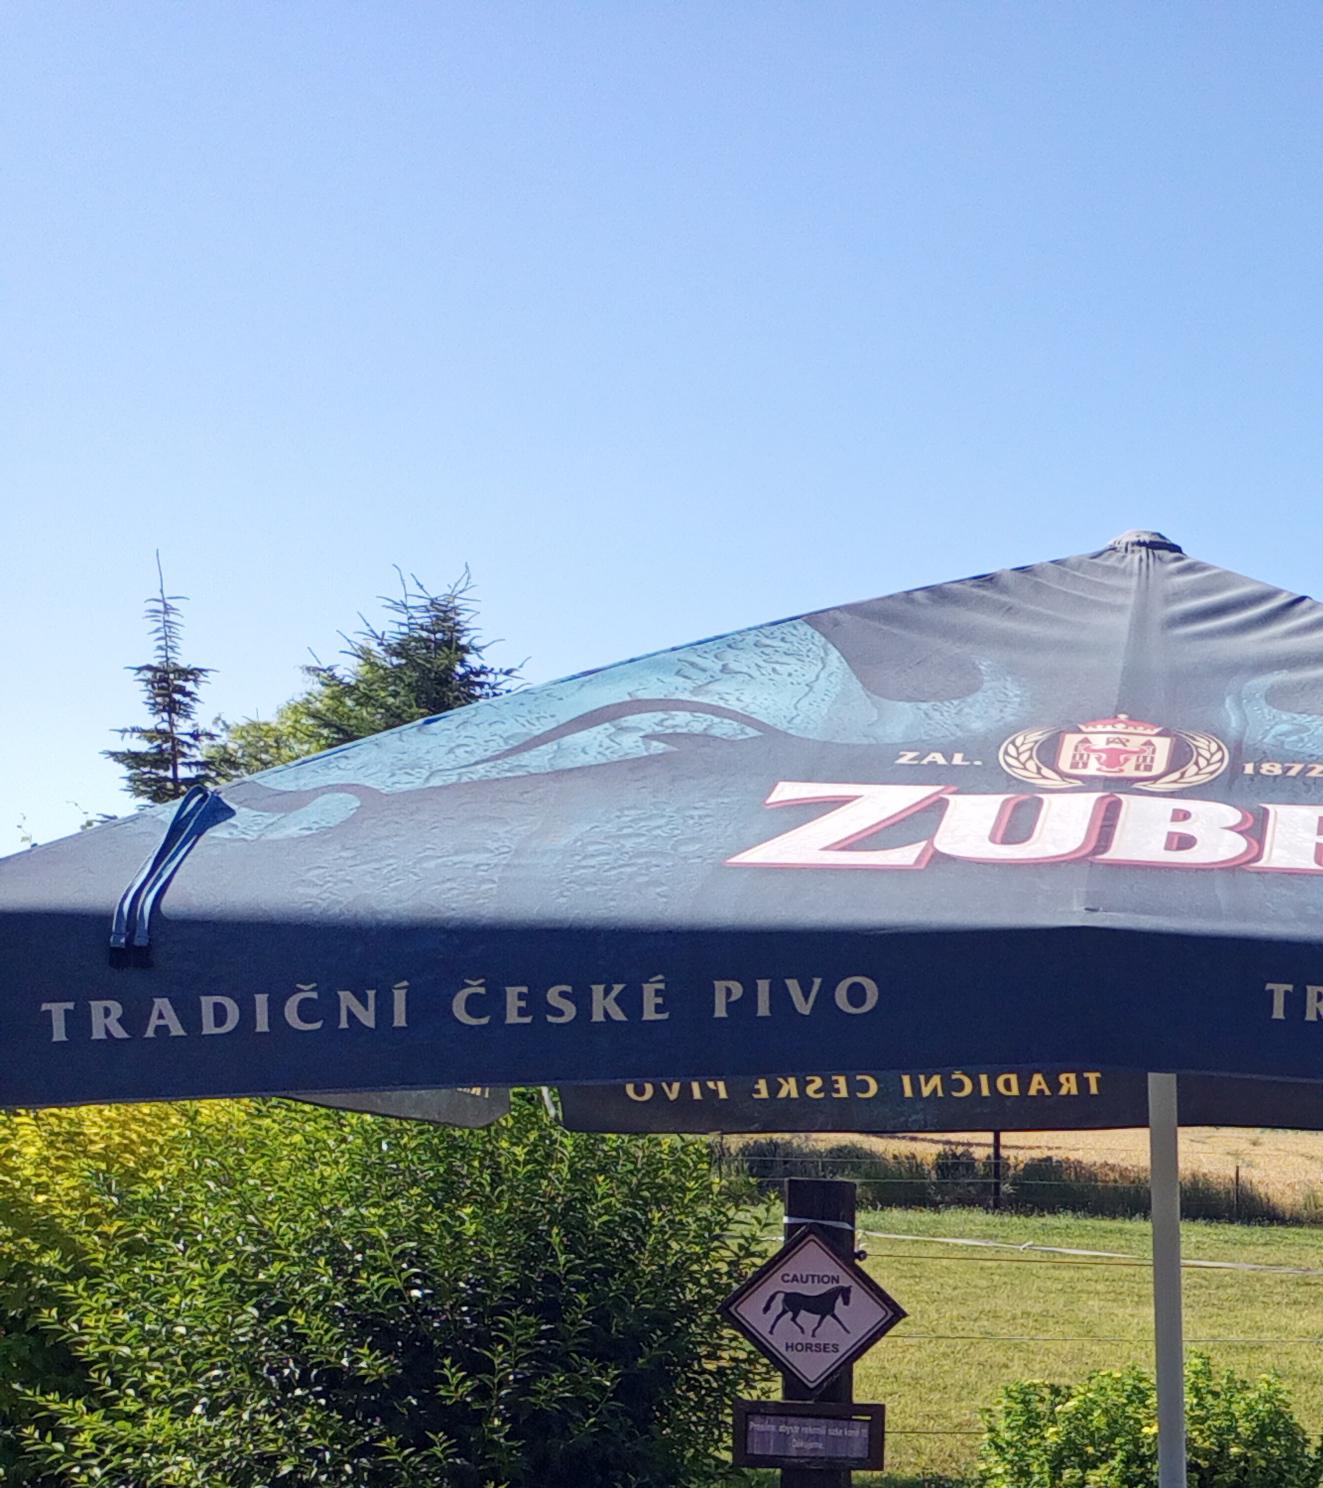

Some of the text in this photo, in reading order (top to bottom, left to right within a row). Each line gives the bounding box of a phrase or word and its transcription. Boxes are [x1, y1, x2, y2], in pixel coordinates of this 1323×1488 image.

[895, 751, 983, 766] ZAL.
[40, 974, 880, 1042] TRADIČNÍ ČESKÉ PIVO
[781, 1273, 840, 1285] CAUTION
[785, 1342, 840, 1353] HORSES
